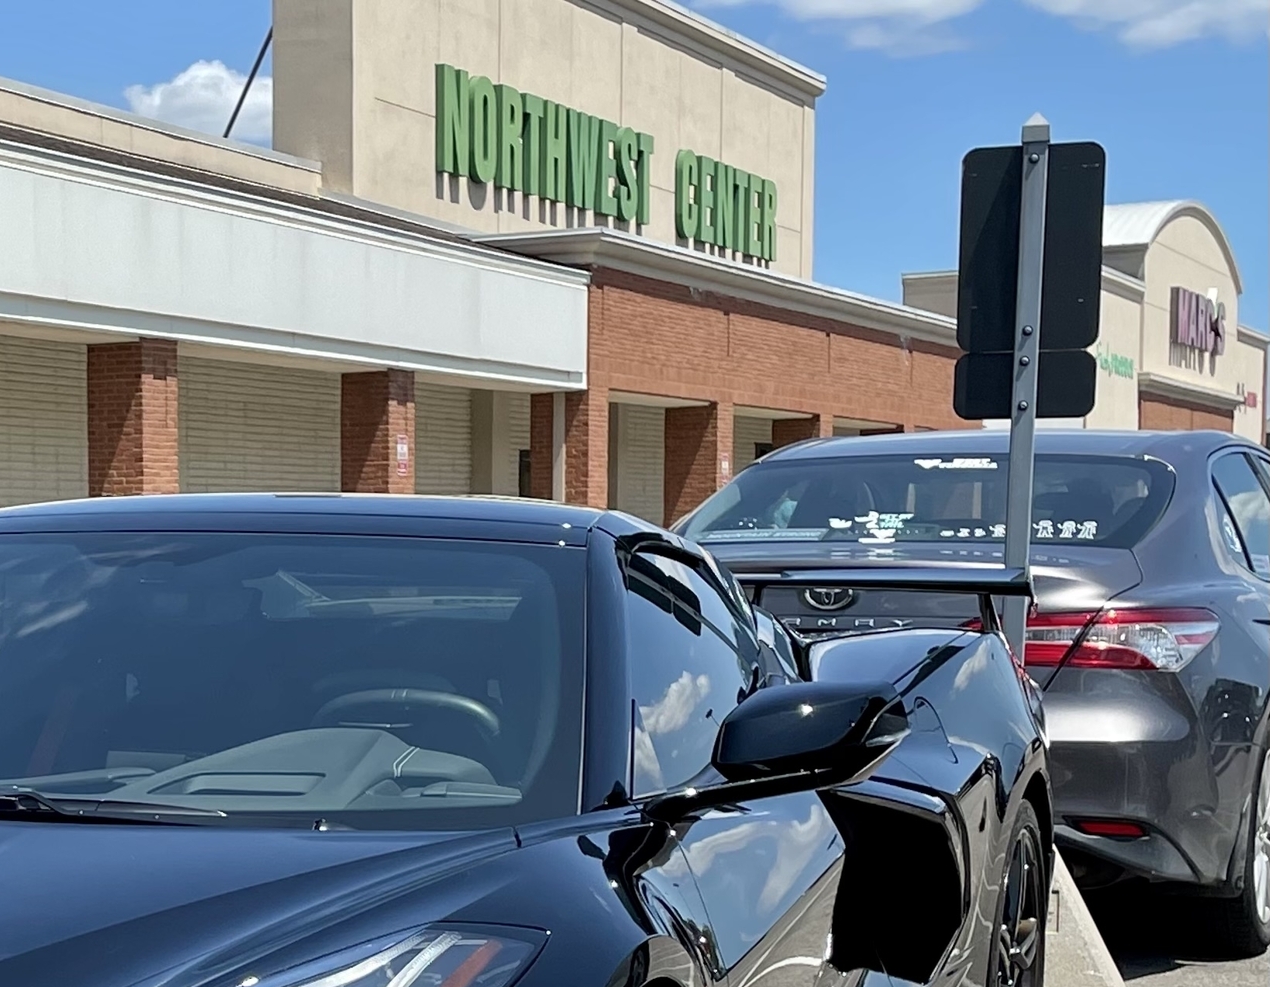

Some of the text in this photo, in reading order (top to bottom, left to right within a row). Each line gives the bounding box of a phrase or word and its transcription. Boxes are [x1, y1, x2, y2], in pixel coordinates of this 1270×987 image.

[435, 63, 777, 262] NORTHWEST CENTER
[780, 616, 914, 628] AMRY
